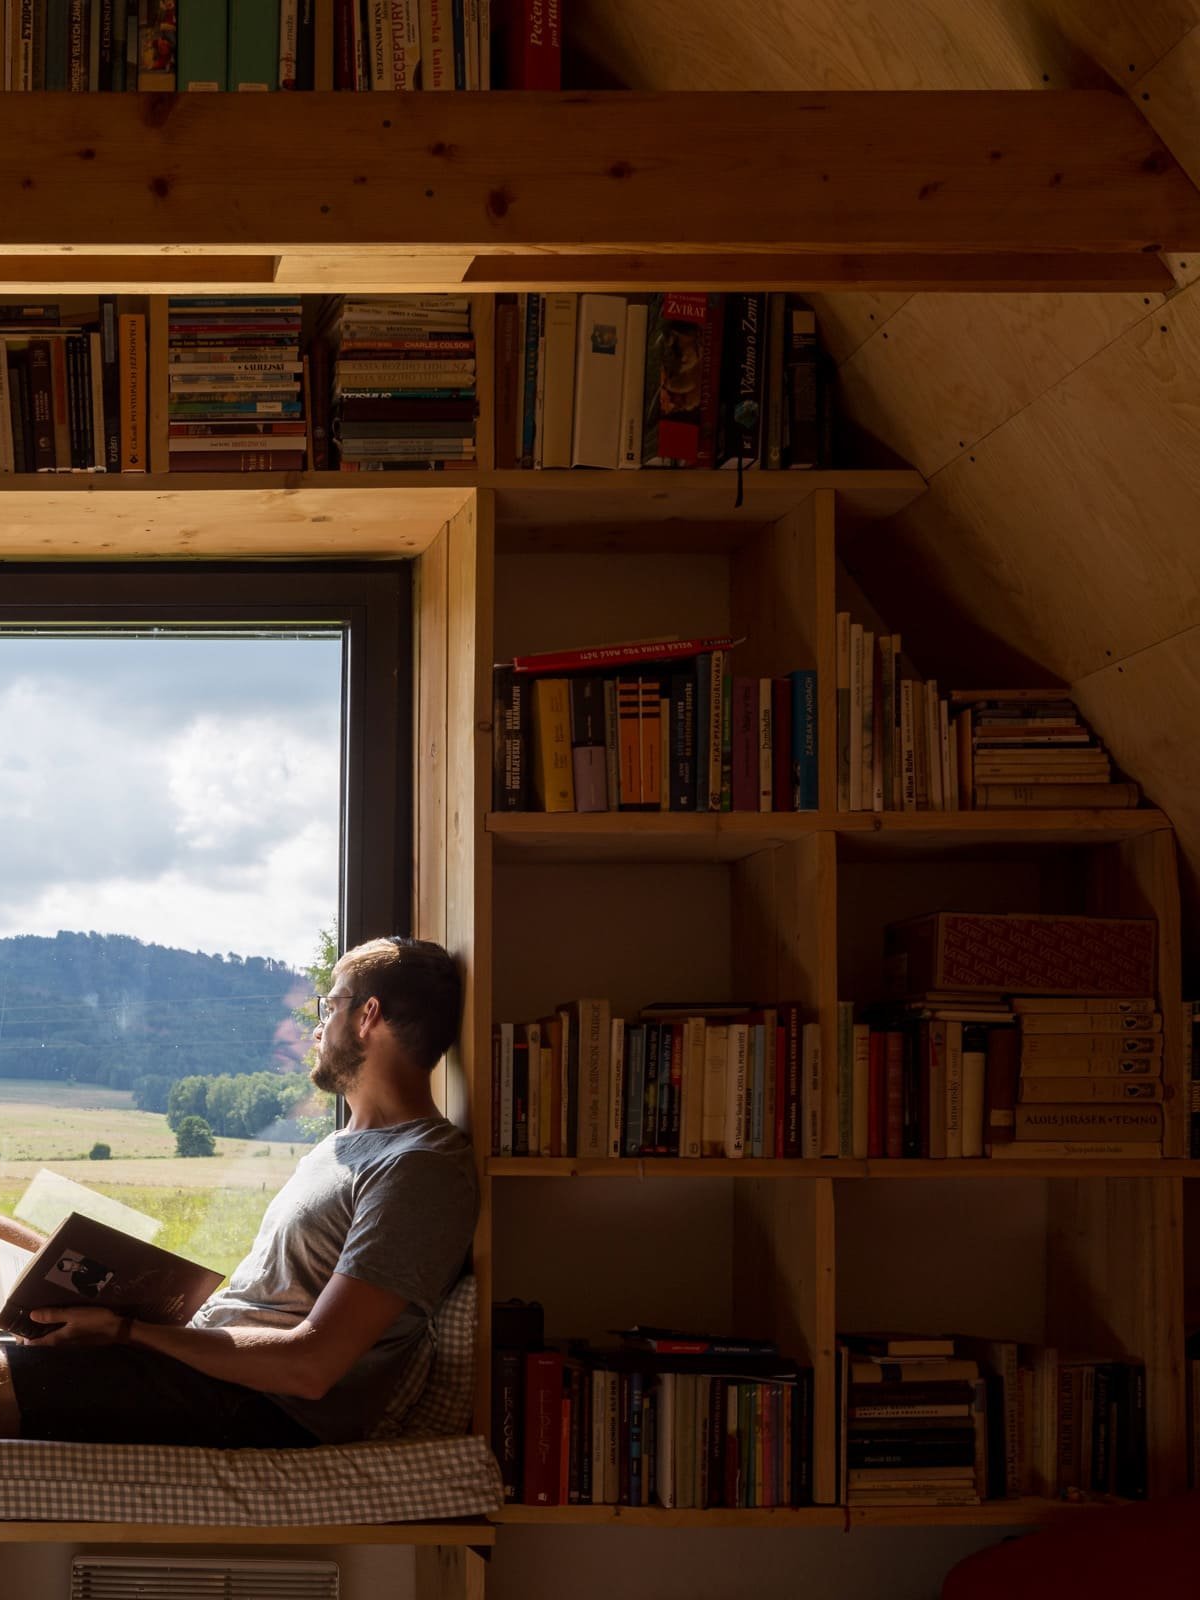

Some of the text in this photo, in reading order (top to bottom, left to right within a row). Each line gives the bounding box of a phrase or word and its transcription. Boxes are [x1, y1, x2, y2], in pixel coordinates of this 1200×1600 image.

[512, 685, 521, 730] KARAMAZOVI
[512, 738, 521, 790] DOSTOJEVSKIJ
[906, 775, 915, 799] Milan
[1024, 1113, 1157, 1127] ALOIS JIRÁSEK TEMNO
[609, 1416, 617, 1446] LONDON
